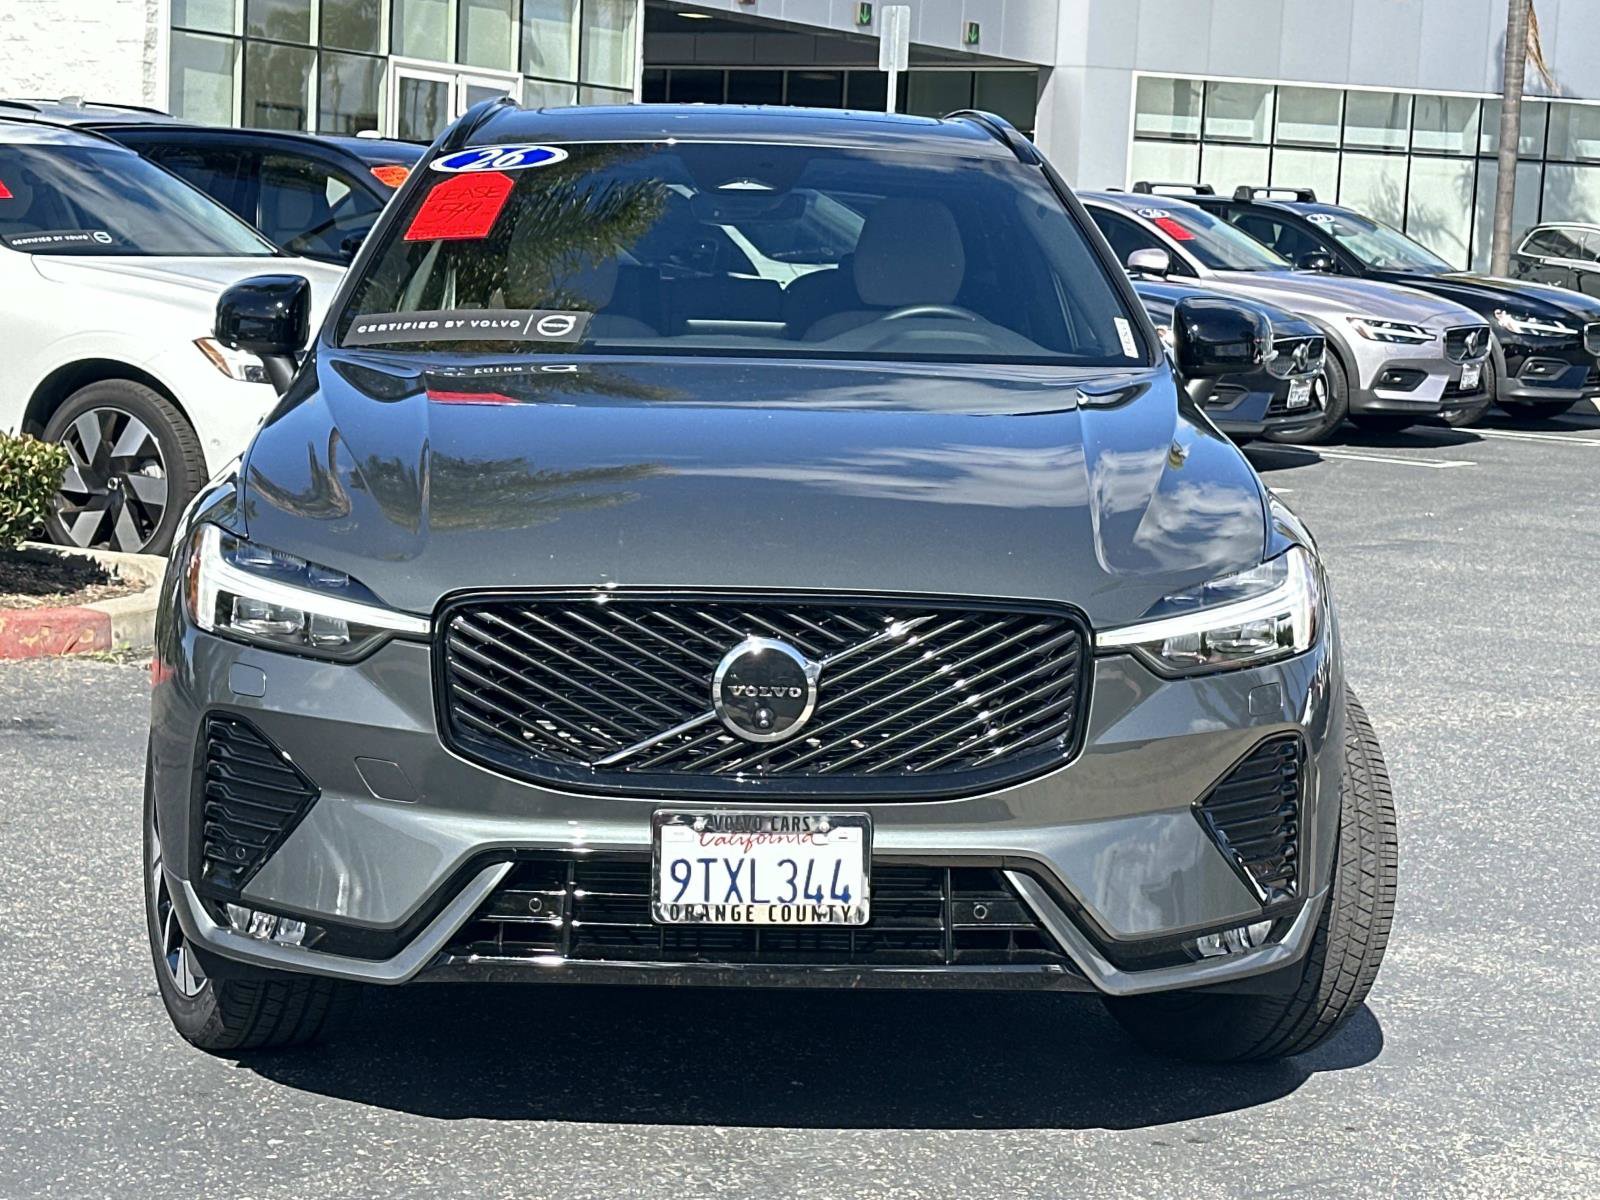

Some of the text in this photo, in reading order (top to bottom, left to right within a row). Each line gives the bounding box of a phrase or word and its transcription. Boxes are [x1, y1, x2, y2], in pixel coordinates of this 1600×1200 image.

[457, 148, 530, 169] 26
[427, 186, 502, 203] LEASE
[357, 320, 520, 333] CERTIFIED BY VOLVO
[727, 685, 802, 698] VOLVO
[712, 815, 811, 832] VOLVO CARS
[699, 831, 829, 854] California
[670, 858, 852, 905] 9TXL344
[669, 904, 852, 923] ORANGE COUNTY
